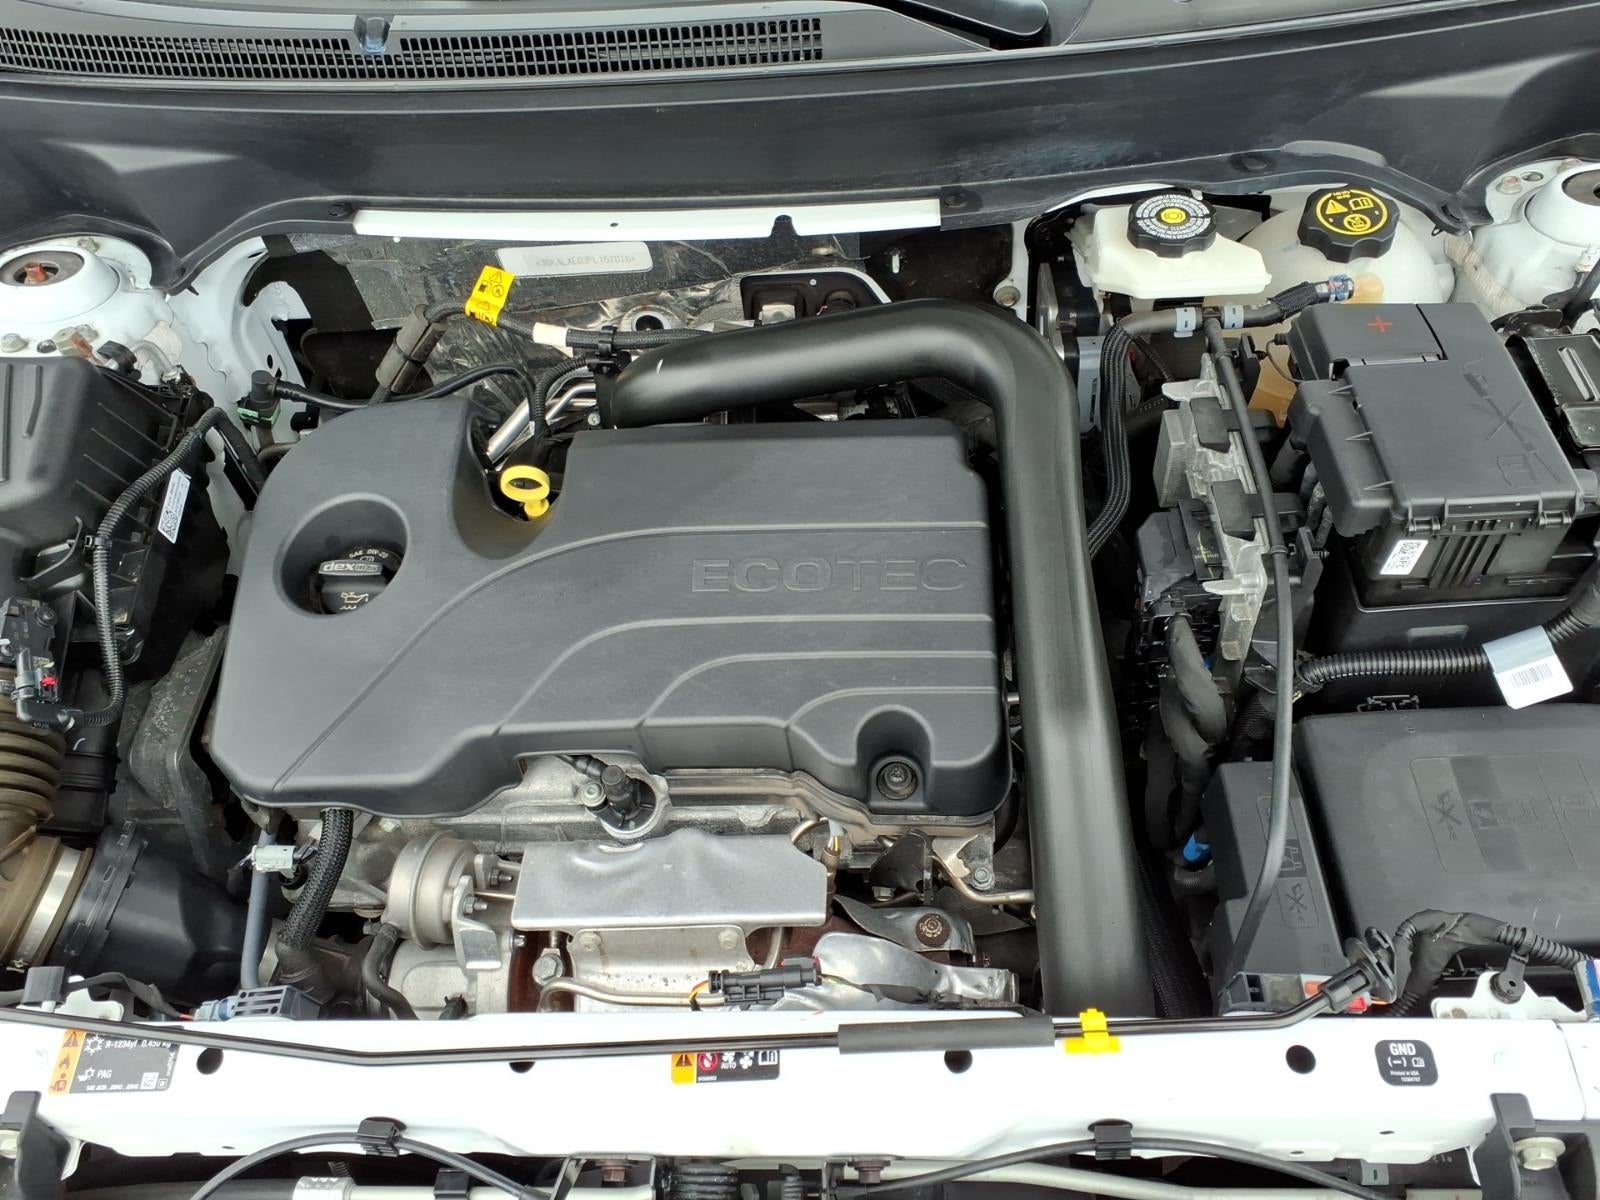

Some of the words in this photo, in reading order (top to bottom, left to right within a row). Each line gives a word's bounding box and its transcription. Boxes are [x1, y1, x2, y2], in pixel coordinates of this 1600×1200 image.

[349, 550, 364, 559] SAE
[691, 557, 968, 592] ECOTEC
[1389, 1042, 1417, 1056] GND
[720, 1062, 737, 1070] AUTO
[97, 1069, 112, 1079] PAG
